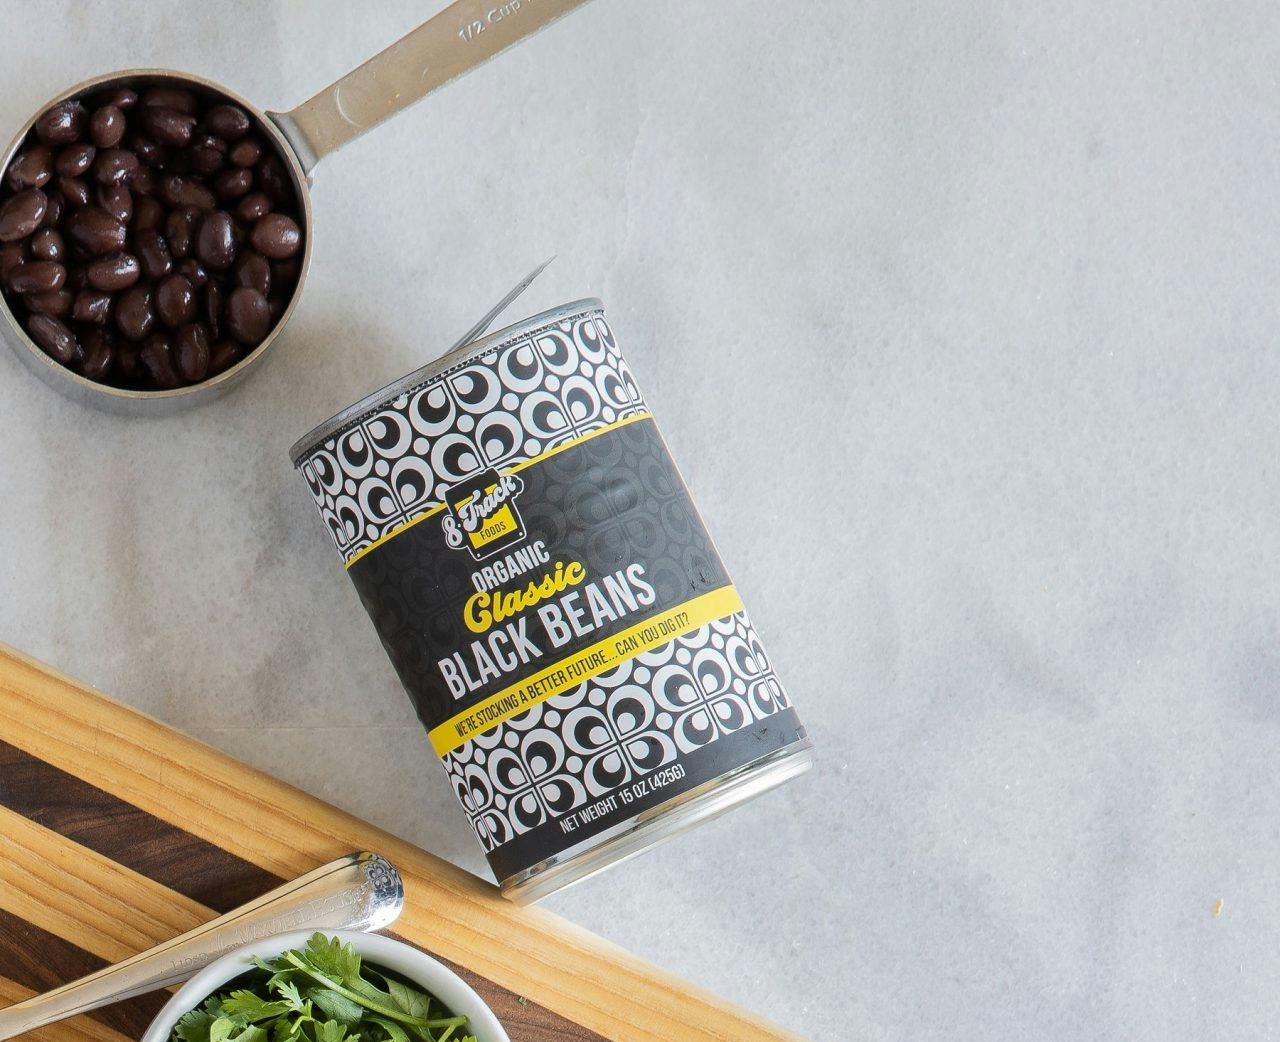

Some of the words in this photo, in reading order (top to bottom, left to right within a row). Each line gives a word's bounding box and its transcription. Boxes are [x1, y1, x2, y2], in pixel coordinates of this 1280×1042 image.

[458, 20, 486, 42] 1/2
[487, 0, 521, 23] Cup
[480, 521, 507, 540] FOODS
[464, 561, 587, 634] Classic
[471, 540, 550, 594] ORGANIC
[437, 617, 544, 700] BLACK
[537, 563, 657, 649] BEANS
[454, 716, 478, 738] WE'RE
[475, 695, 520, 727] STOCKING
[520, 690, 529, 704] A
[528, 669, 568, 700] BETTER
[637, 626, 661, 646] YOU
[659, 618, 677, 636] DIG
[675, 611, 691, 628] IT?
[559, 812, 580, 834] NET
[578, 795, 619, 824] WEIGHT
[618, 788, 635, 805] 15
[632, 780, 651, 799] OZ
[648, 763, 686, 791] (425G)
